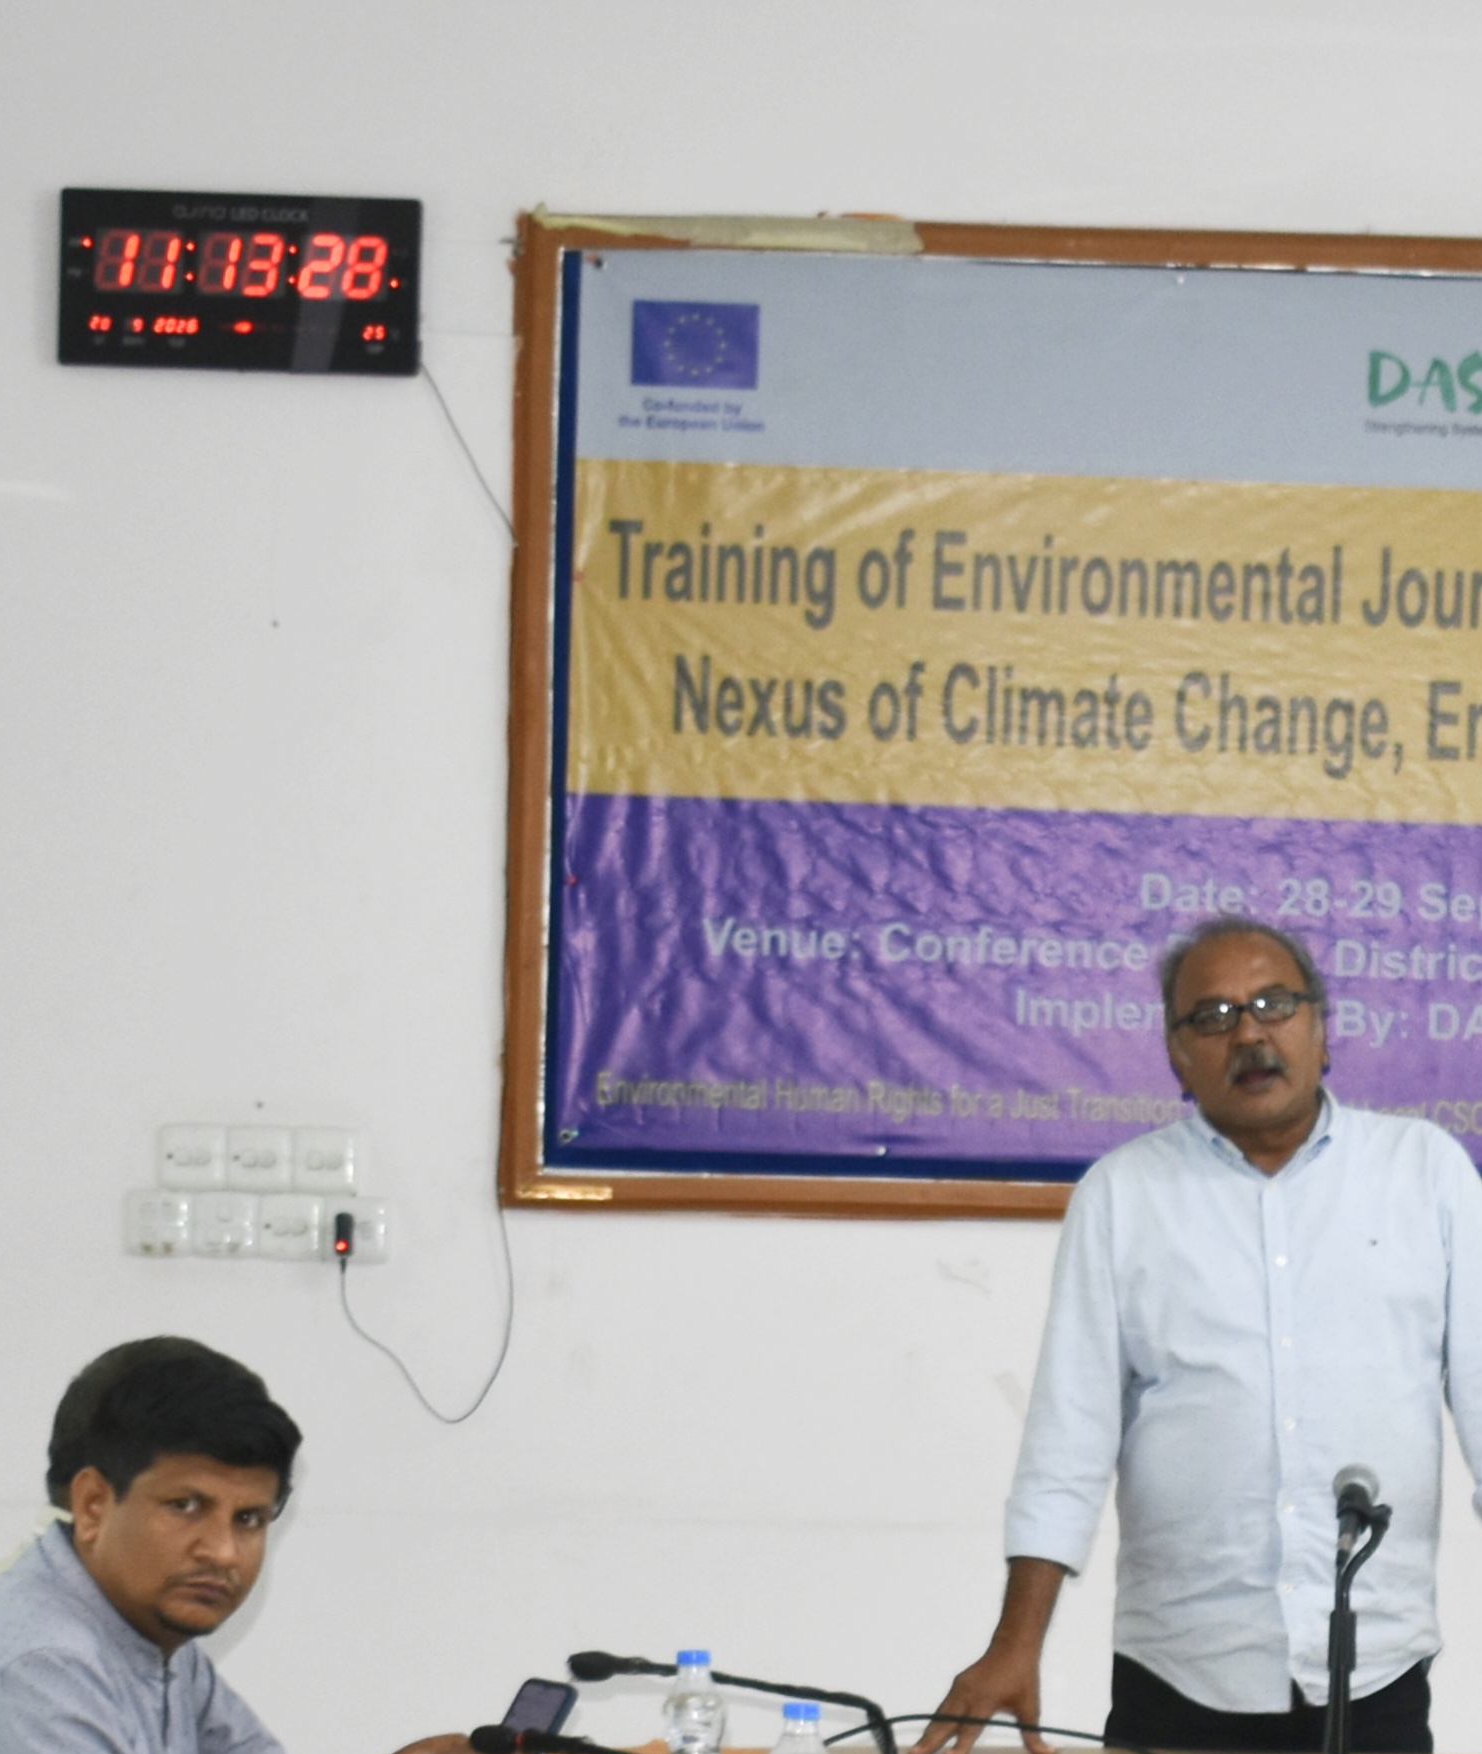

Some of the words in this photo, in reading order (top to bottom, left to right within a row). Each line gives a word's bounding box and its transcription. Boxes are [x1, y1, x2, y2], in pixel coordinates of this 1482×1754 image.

[116, 231, 388, 299] 11:13:28
[608, 519, 836, 630] Training
[857, 528, 916, 611] of
[931, 530, 1342, 625] Environmental
[673, 653, 846, 742] Nexus
[868, 660, 926, 743] of
[942, 664, 1154, 755] Climate
[1175, 670, 1404, 780] Change,
[1140, 872, 1259, 916] Date:
[1278, 876, 1401, 921] 28-29
[701, 917, 862, 963] Venue:
[879, 922, 1149, 973] Conference
[1335, 999, 1411, 1050] By:
[949, 1083, 979, 1118] for
[988, 1093, 1004, 1118] a
